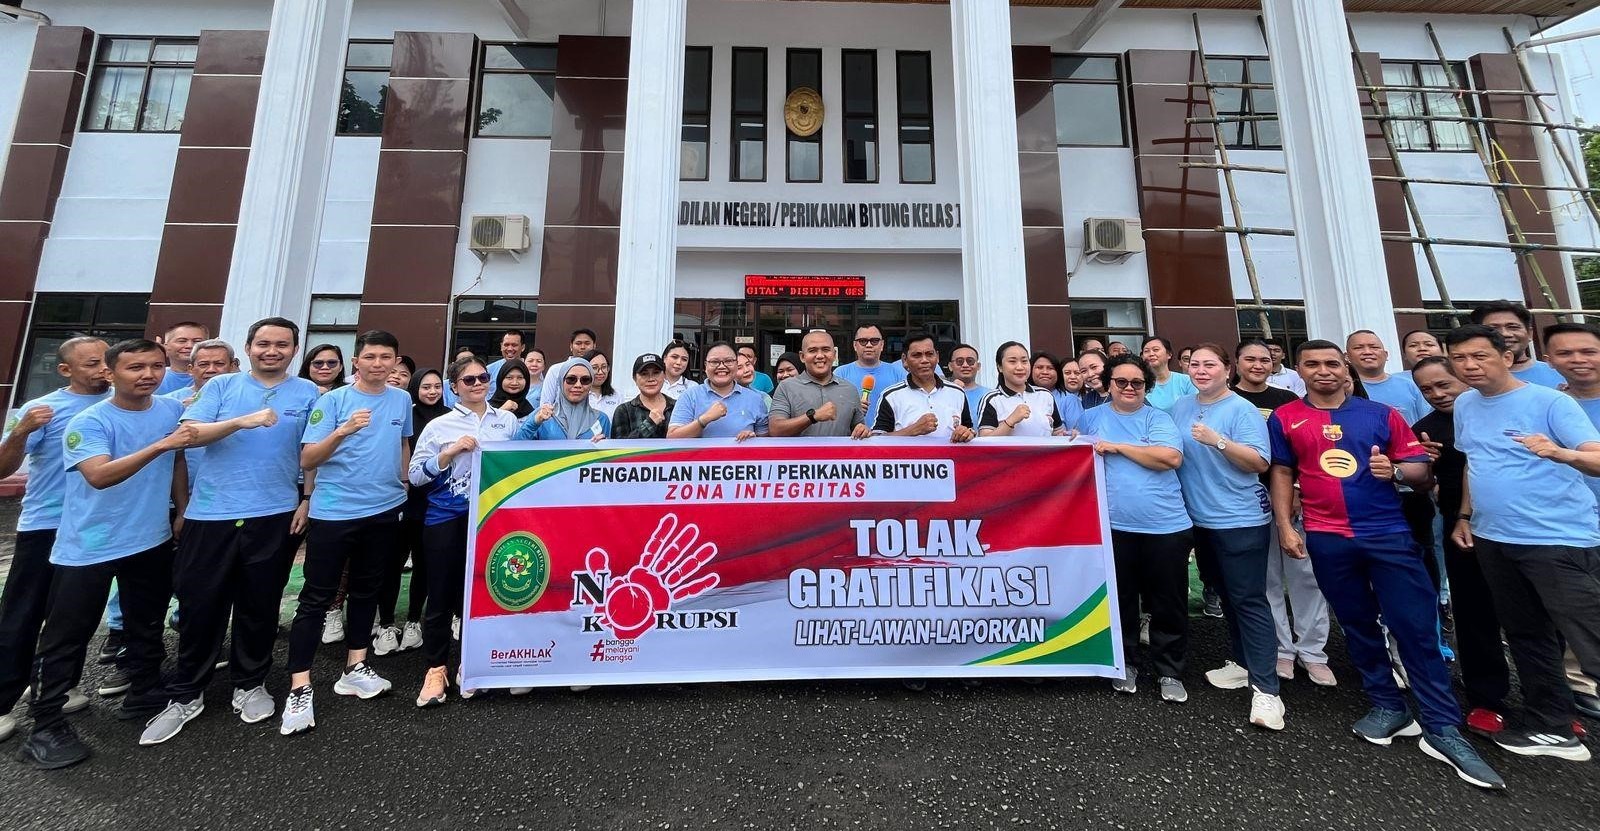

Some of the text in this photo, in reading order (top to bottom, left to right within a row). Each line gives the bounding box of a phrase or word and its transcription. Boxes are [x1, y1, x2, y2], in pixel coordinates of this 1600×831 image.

[678, 201, 720, 226] DILAN
[859, 203, 910, 228] BITUNG
[912, 203, 954, 228] KELAS
[790, 287, 840, 296] DISIPLIN
[579, 465, 693, 483] PENGADILAN
[699, 464, 762, 481] NEGERI
[777, 463, 877, 480] PERIKANAN
[883, 462, 949, 479] BITUNG
[665, 481, 866, 500] ZONA INTEGRITAS
[850, 519, 985, 557] TOLAK
[788, 566, 1050, 608] GRATIFIKASI
[491, 648, 552, 660] BerAKHLAK
[605, 645, 640, 655] melayani
[605, 654, 633, 663] bangsa
